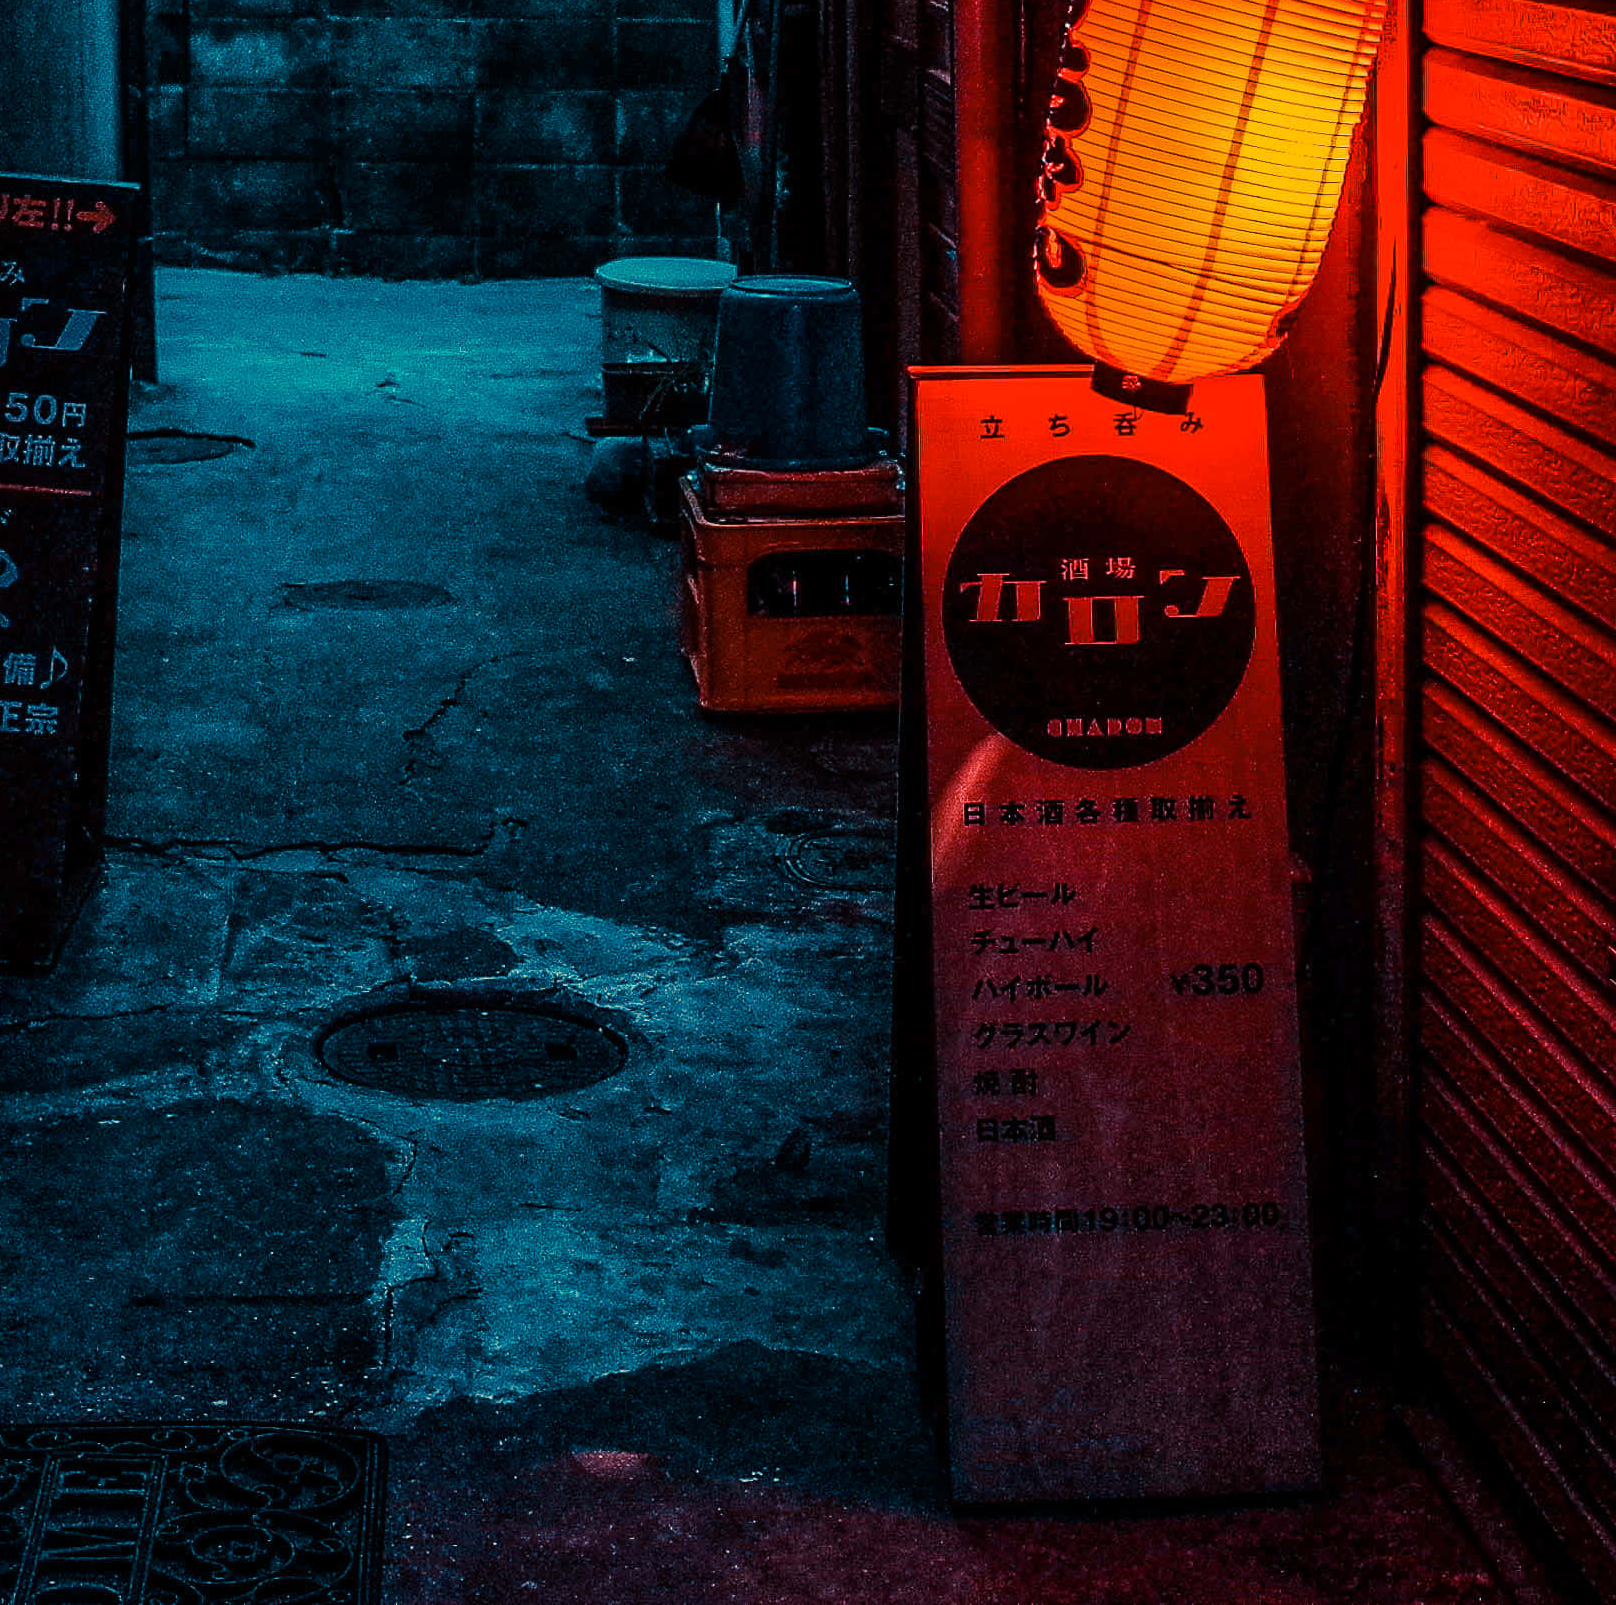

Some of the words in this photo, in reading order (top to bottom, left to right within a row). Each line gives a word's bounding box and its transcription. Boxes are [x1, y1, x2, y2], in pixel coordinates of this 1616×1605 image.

[1060, 556, 1137, 582] 酒場
[968, 882, 1077, 911] 生ビール
[969, 927, 1099, 955] チューハイ
[972, 973, 1108, 1001] ハイボール
[973, 1020, 1131, 1049] グラスワイン
[976, 1115, 1056, 1143] 日本酒
